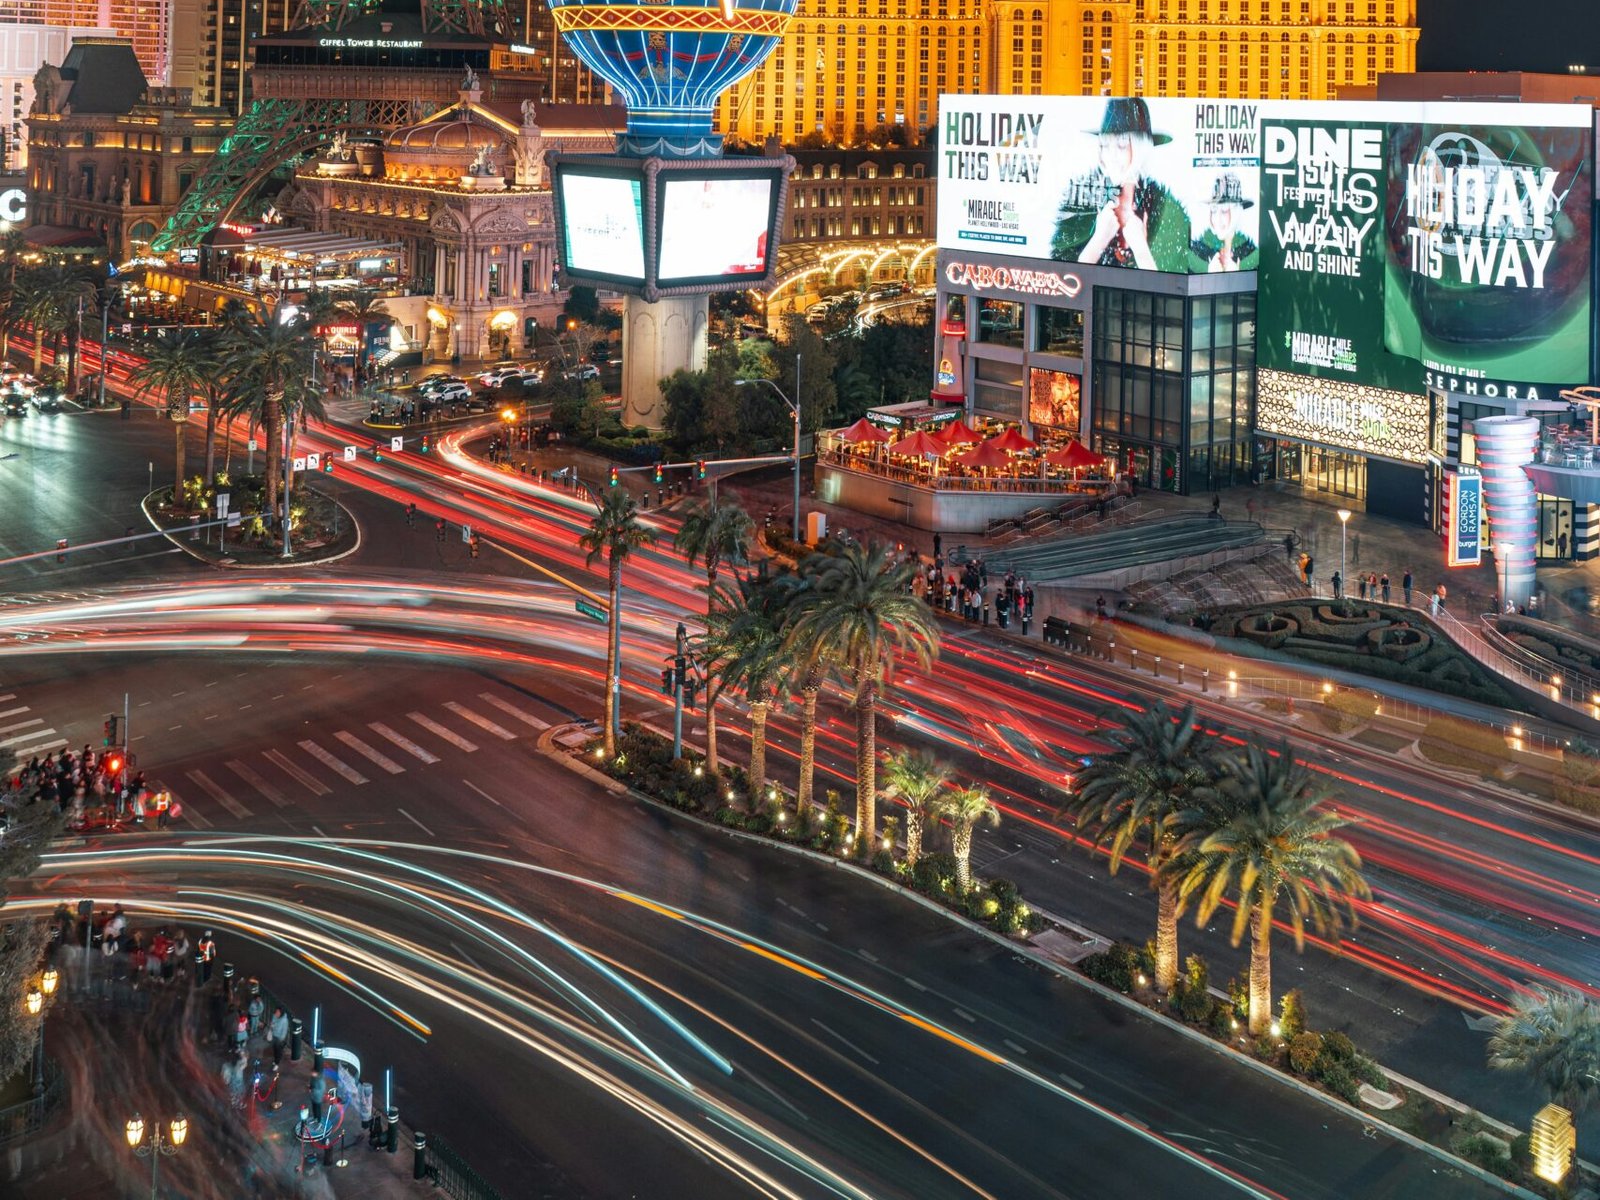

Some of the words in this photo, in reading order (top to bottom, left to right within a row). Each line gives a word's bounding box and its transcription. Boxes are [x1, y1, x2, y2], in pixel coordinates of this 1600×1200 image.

[320, 38, 345, 47] EIFFEL
[347, 38, 373, 47] TOWER
[376, 39, 423, 48] RESTAURANT
[945, 111, 1044, 149] HOLIDAY
[1195, 104, 1257, 130] HOLIDAY
[1195, 133, 1224, 154] THIS
[1228, 133, 1257, 154] WAY
[1264, 126, 1382, 170] DINE
[945, 150, 989, 181] THIS
[995, 152, 1042, 185] WAY
[967, 199, 1002, 221] MIRACLE
[1284, 250, 1313, 271] AND
[1317, 253, 1361, 277] SHINE
[1454, 235, 1556, 288] WAY
[945, 262, 1012, 290] CABO
[1014, 285, 1056, 296] CANTINA
[1292, 331, 1336, 360] MIRACLE
[1426, 372, 1539, 400] SEPHORA
[1296, 391, 1360, 437] MIRACLE
[1460, 490, 1468, 533] GORDON
[1468, 490, 1477, 533] RAMSAY
